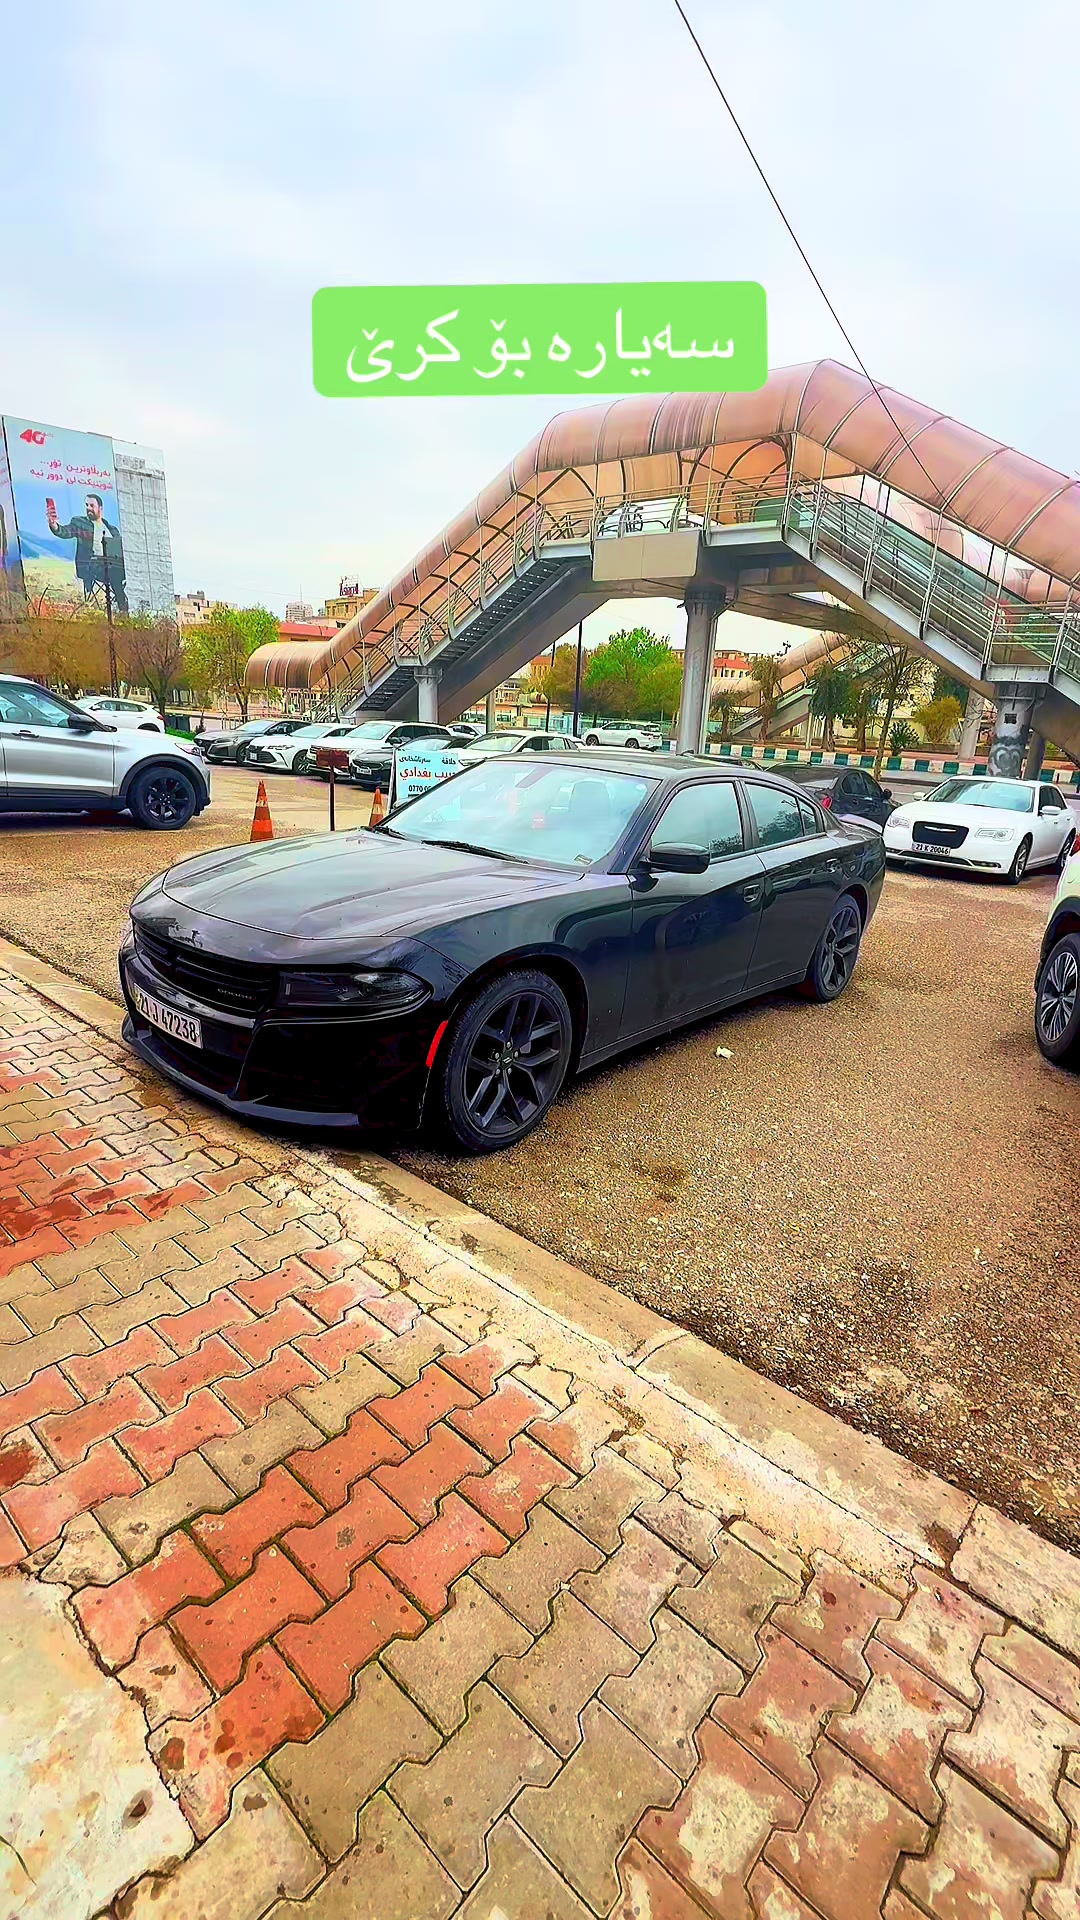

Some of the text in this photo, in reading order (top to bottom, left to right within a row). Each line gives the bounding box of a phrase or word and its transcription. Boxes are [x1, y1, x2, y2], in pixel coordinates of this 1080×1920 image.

[399, 766, 432, 781] بغدادي
[139, 992, 197, 1042] 21 J 47238
